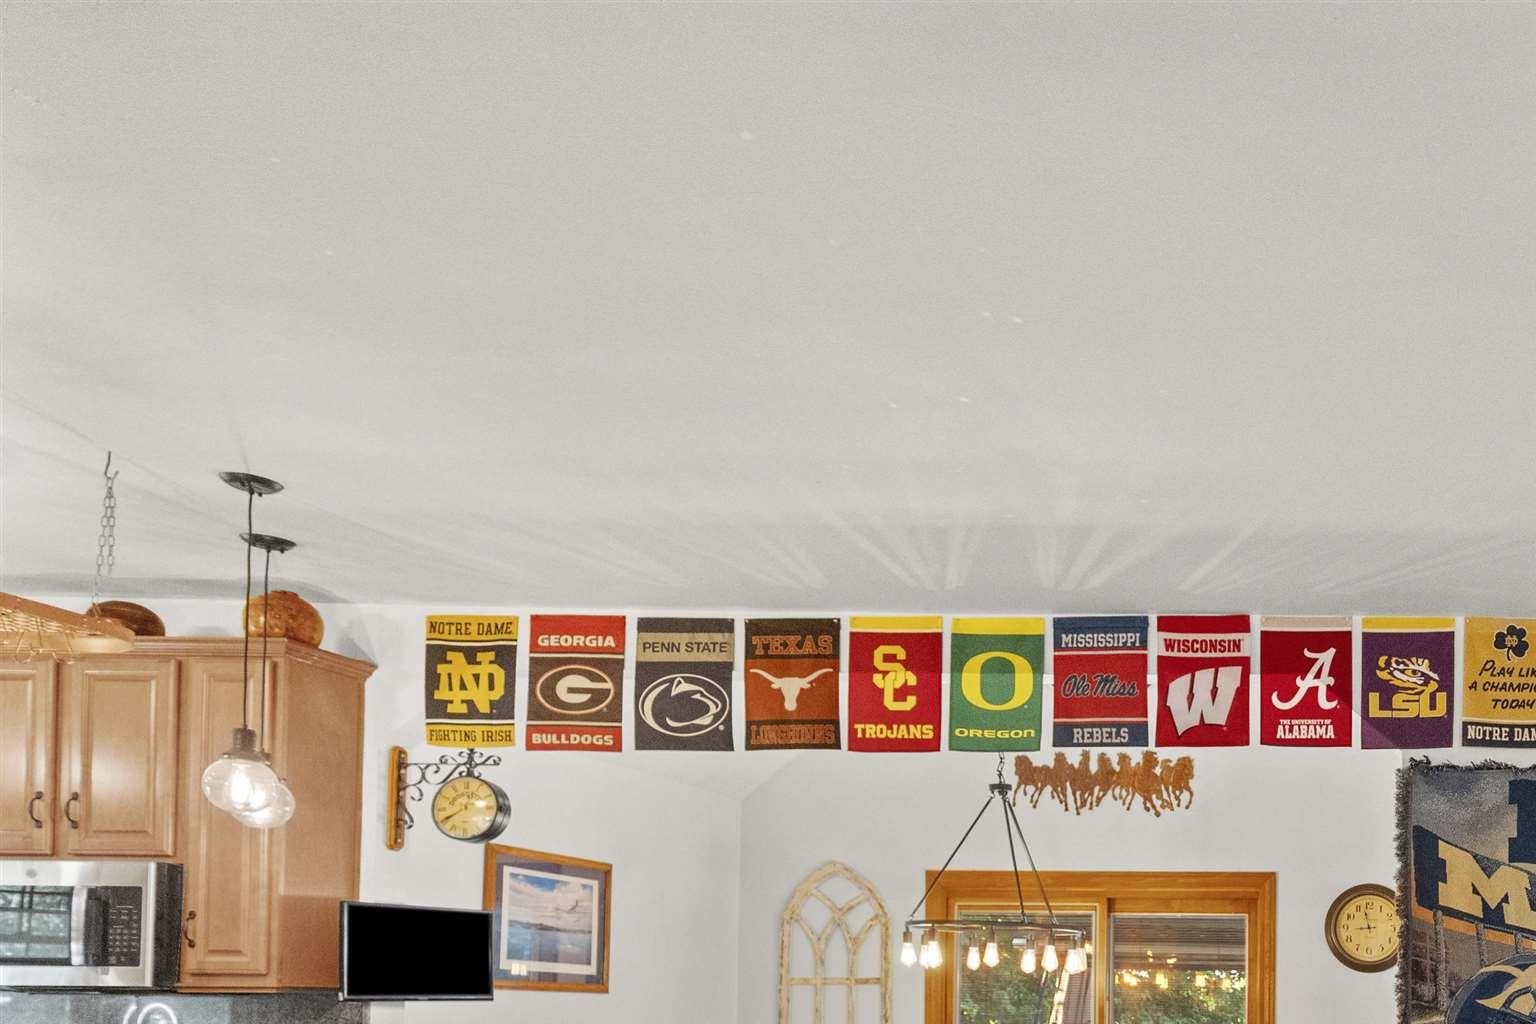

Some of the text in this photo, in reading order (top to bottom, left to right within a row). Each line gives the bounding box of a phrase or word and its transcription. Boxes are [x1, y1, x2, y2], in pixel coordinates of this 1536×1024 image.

[429, 621, 513, 635] NOTRE DAME
[537, 635, 616, 648] GEORGIA
[642, 642, 729, 653] PENN STATE
[752, 635, 833, 655] TEXAS
[1061, 633, 1140, 648] MISSISSIPPI
[1163, 638, 1242, 653] WISCONSIN
[961, 651, 1034, 711] O
[1062, 673, 1139, 698] Ole Miss
[1271, 647, 1338, 710] A
[1468, 681, 1478, 691] A
[555, 674, 613, 703] G
[1166, 665, 1243, 738] W
[1368, 692, 1447, 718] LSU
[1491, 699, 1536, 710] TODAY
[428, 729, 513, 742] FIGHTING IRISH
[531, 733, 614, 745] BULLDOGS
[854, 724, 934, 739] TROJANS
[954, 728, 1035, 739] OREGON
[1072, 728, 1129, 744] REBELS
[1276, 724, 1335, 739] ALABAMA
[1467, 725, 1510, 741] NOTRE
